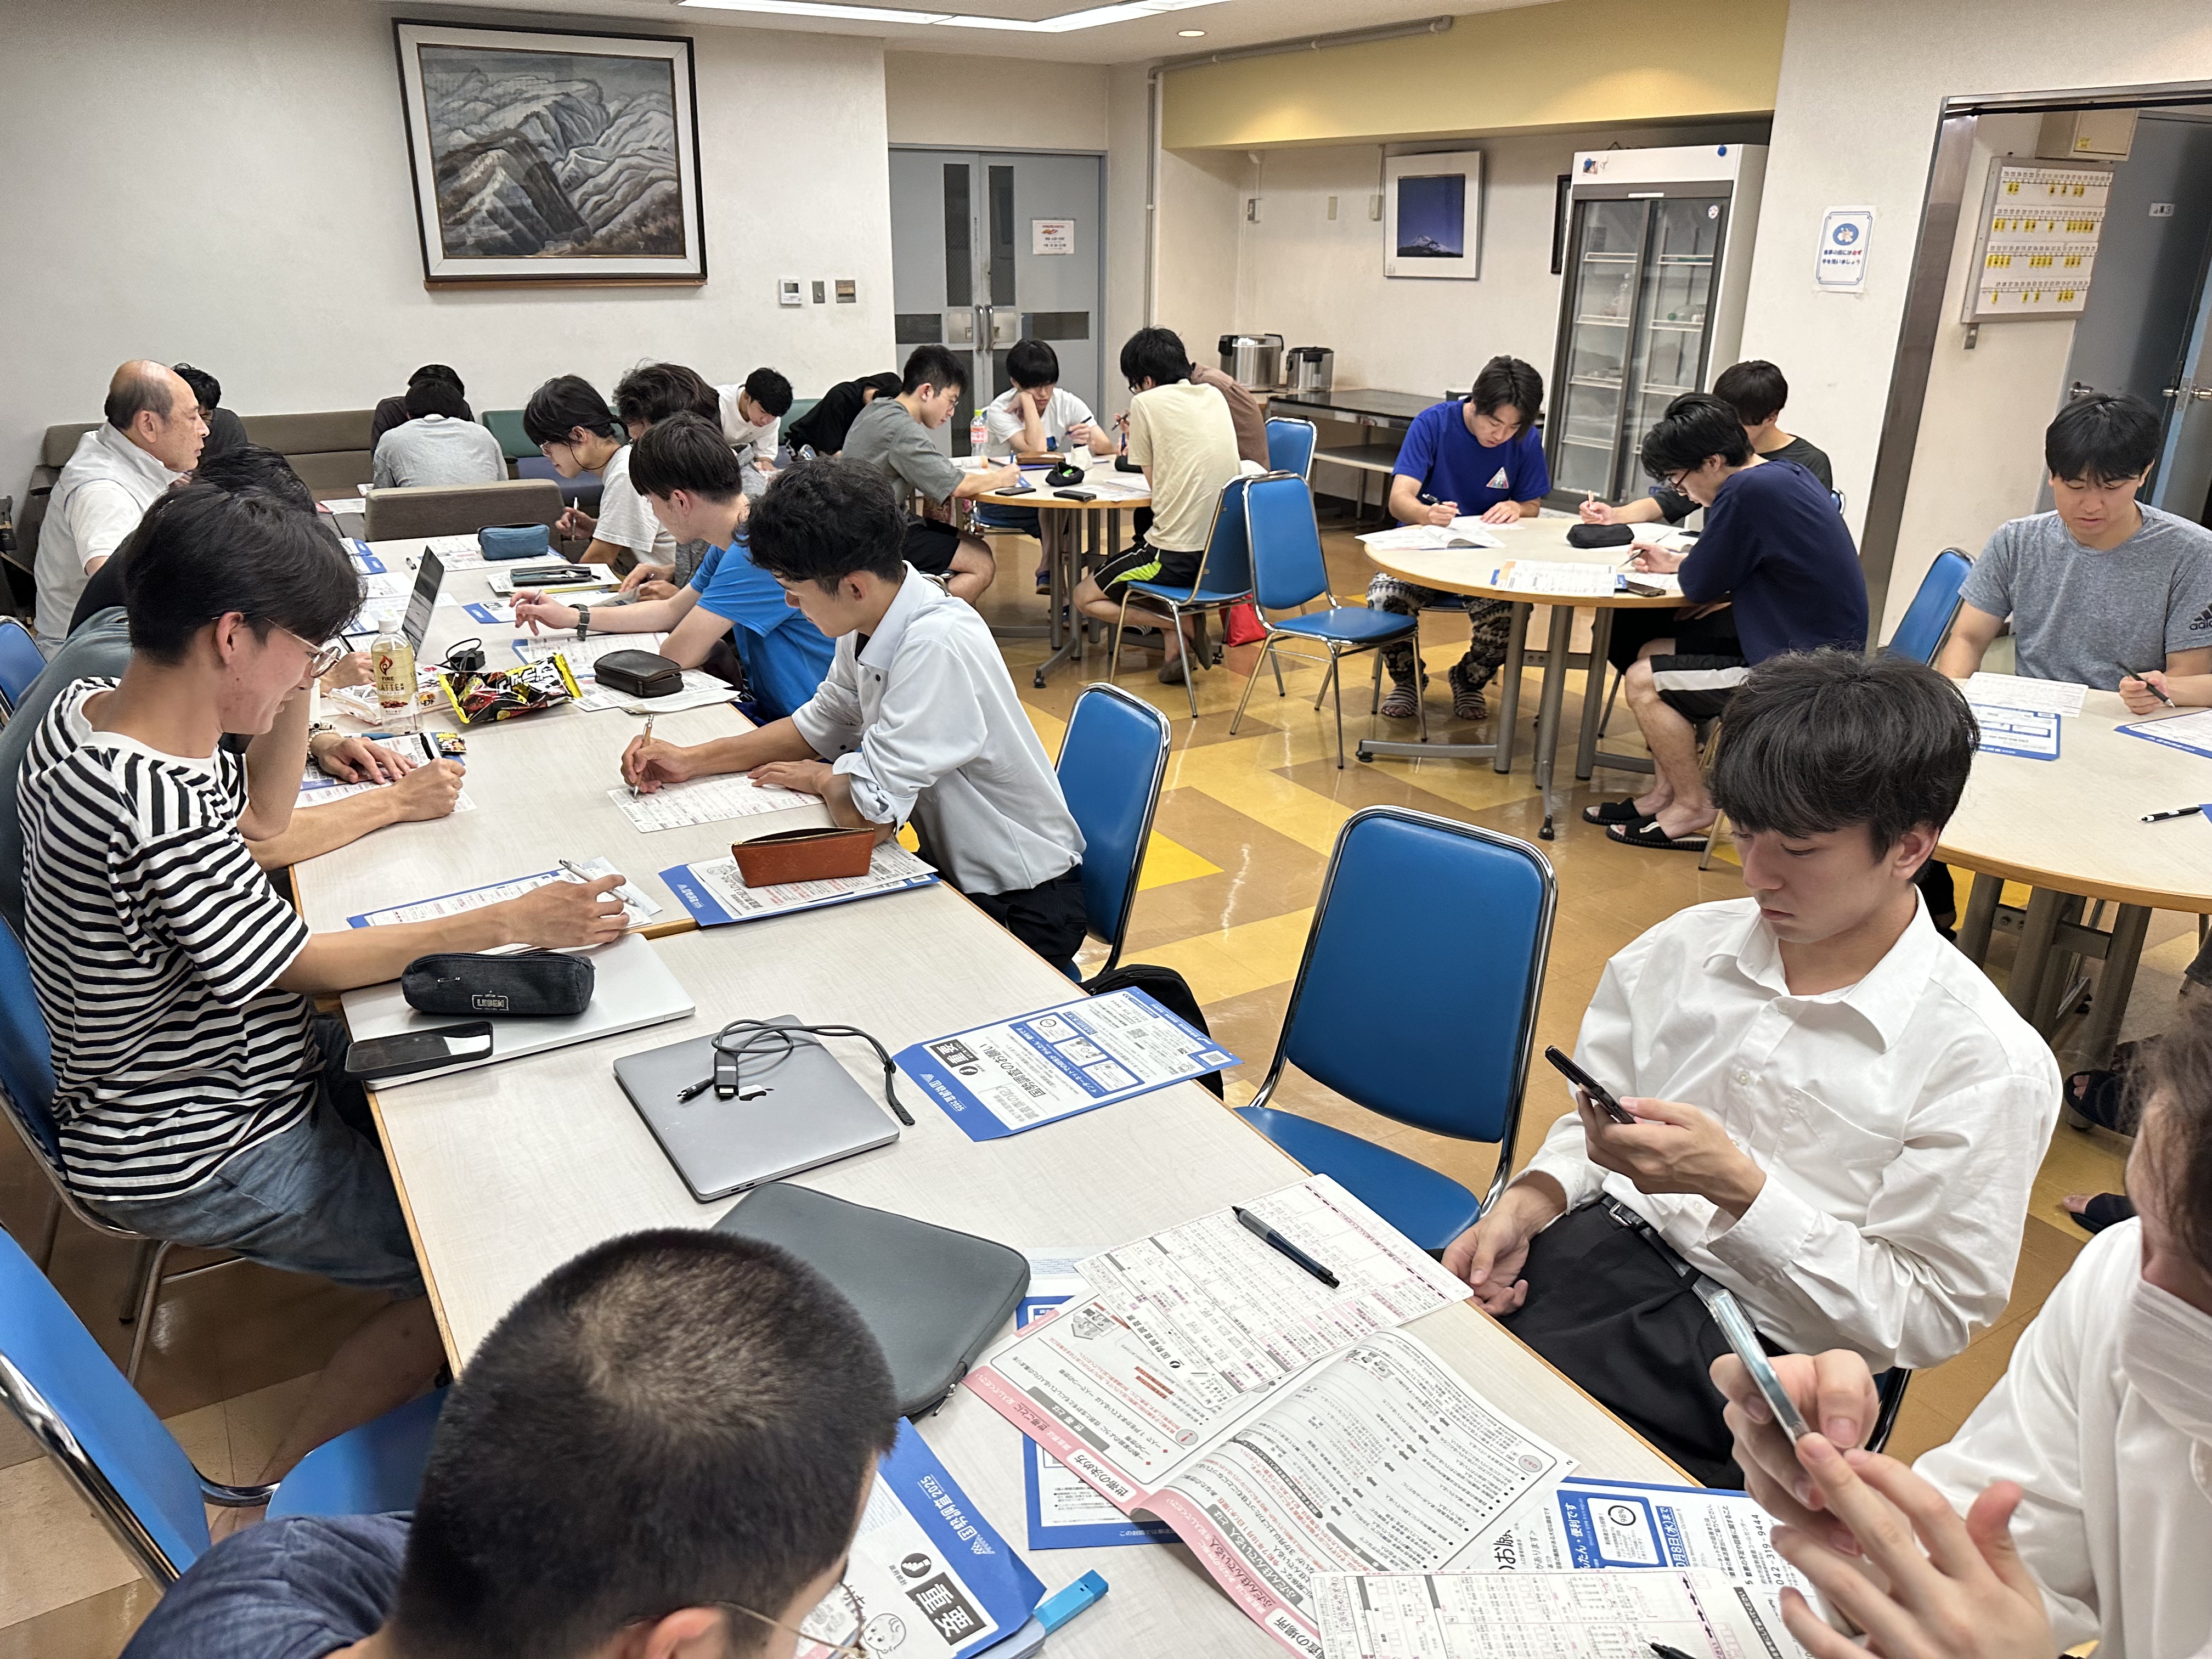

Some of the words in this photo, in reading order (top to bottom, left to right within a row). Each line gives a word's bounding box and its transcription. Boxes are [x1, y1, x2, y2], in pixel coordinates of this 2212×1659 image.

[477, 998, 504, 1007] LEBEN
[935, 1042, 970, 1064] 重要
[977, 1042, 1046, 1097] 国勢調査のお願い
[929, 1080, 964, 1112] 国勢調査2025
[1126, 1314, 1171, 1359] 国勢調査調査票
[974, 1372, 1015, 1405] 記入してください
[1058, 1368, 1096, 1397] 一人で一つの世帯
[1012, 1403, 1048, 1431] 世帯ごとに
[1046, 1430, 1072, 1451] 調査票は
[1099, 1425, 1146, 1461] 一般の家庭のように
[1124, 1435, 1152, 1456] 一つの世帯
[1073, 1453, 1128, 1498] 世帯の決め方
[1522, 1457, 1538, 1469] Q&A
[921, 1475, 978, 1541] 国勢調査2025
[1166, 1498, 1211, 1540] を記入してください
[1214, 1510, 1229, 1526] とは
[1618, 1509, 1627, 1522] 98%
[1707, 1504, 1735, 1577] 査票の郵送提出にご協力ください。
[1752, 1515, 1784, 1585] 042-319-9444
[889, 1564, 909, 1586] 政府統計
[1209, 1538, 1274, 1606] ふだん住んでいる人
[1231, 1527, 1298, 1598] ふだん住んでいる人
[916, 1583, 974, 1638] 重要
